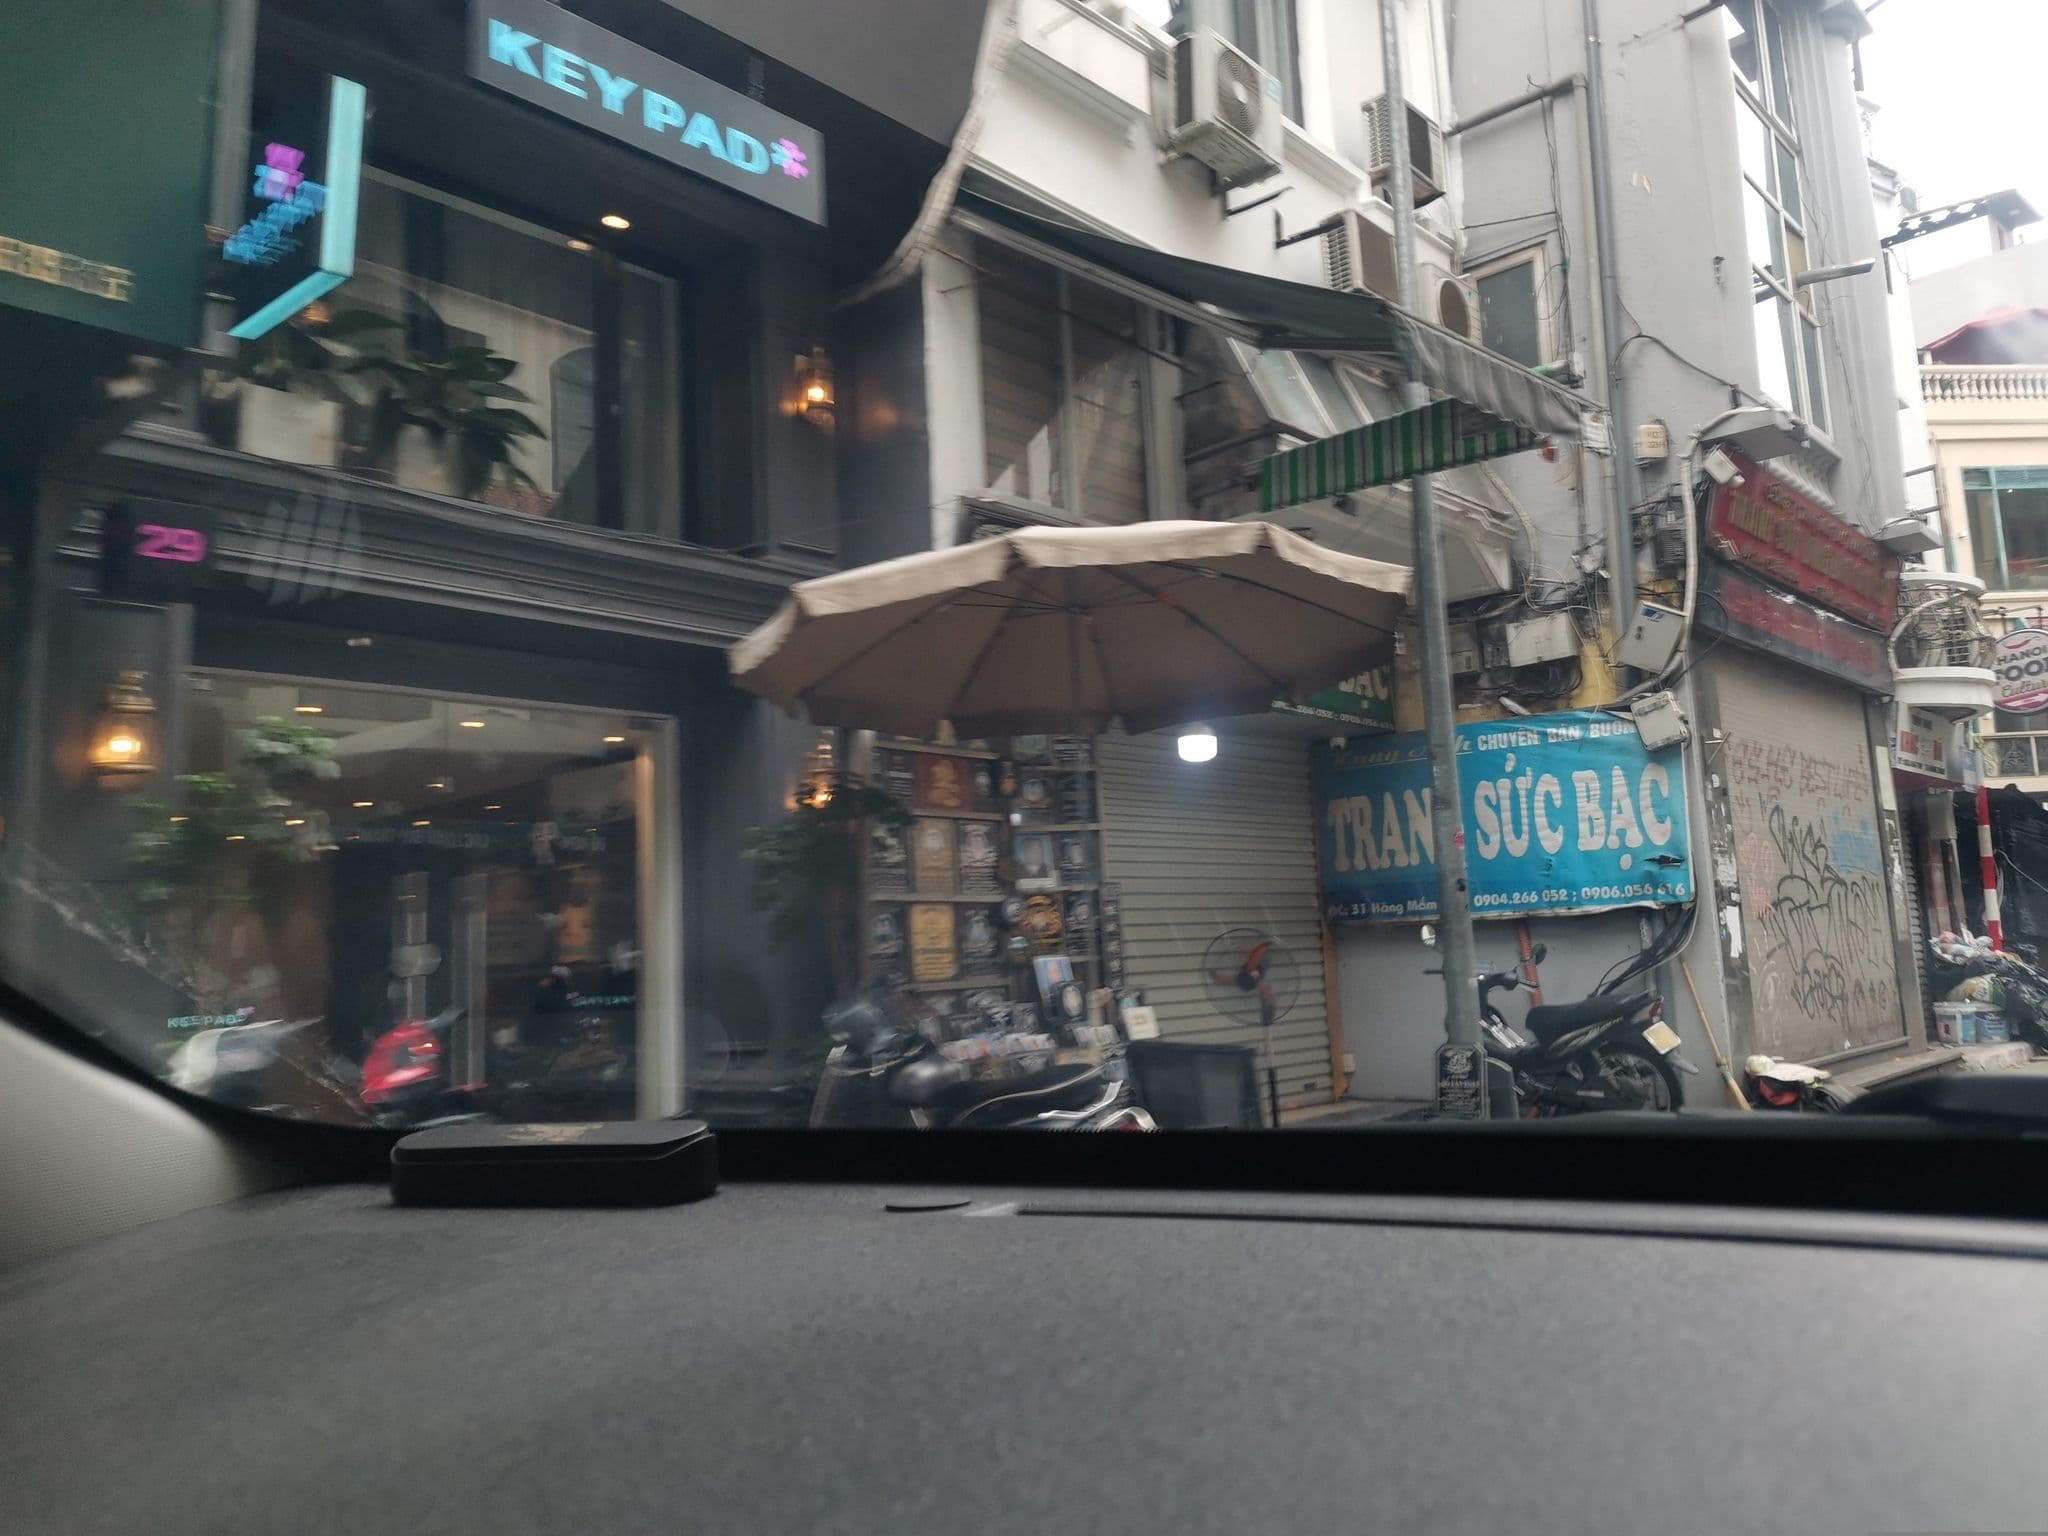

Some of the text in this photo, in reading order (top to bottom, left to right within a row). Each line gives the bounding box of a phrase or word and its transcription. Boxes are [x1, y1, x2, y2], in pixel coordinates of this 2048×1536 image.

[488, 18, 771, 176] KEYPAD
[1327, 787, 1435, 872] TRAN
[1474, 753, 1564, 860] SỨC
[1572, 762, 1672, 870] BẠC
